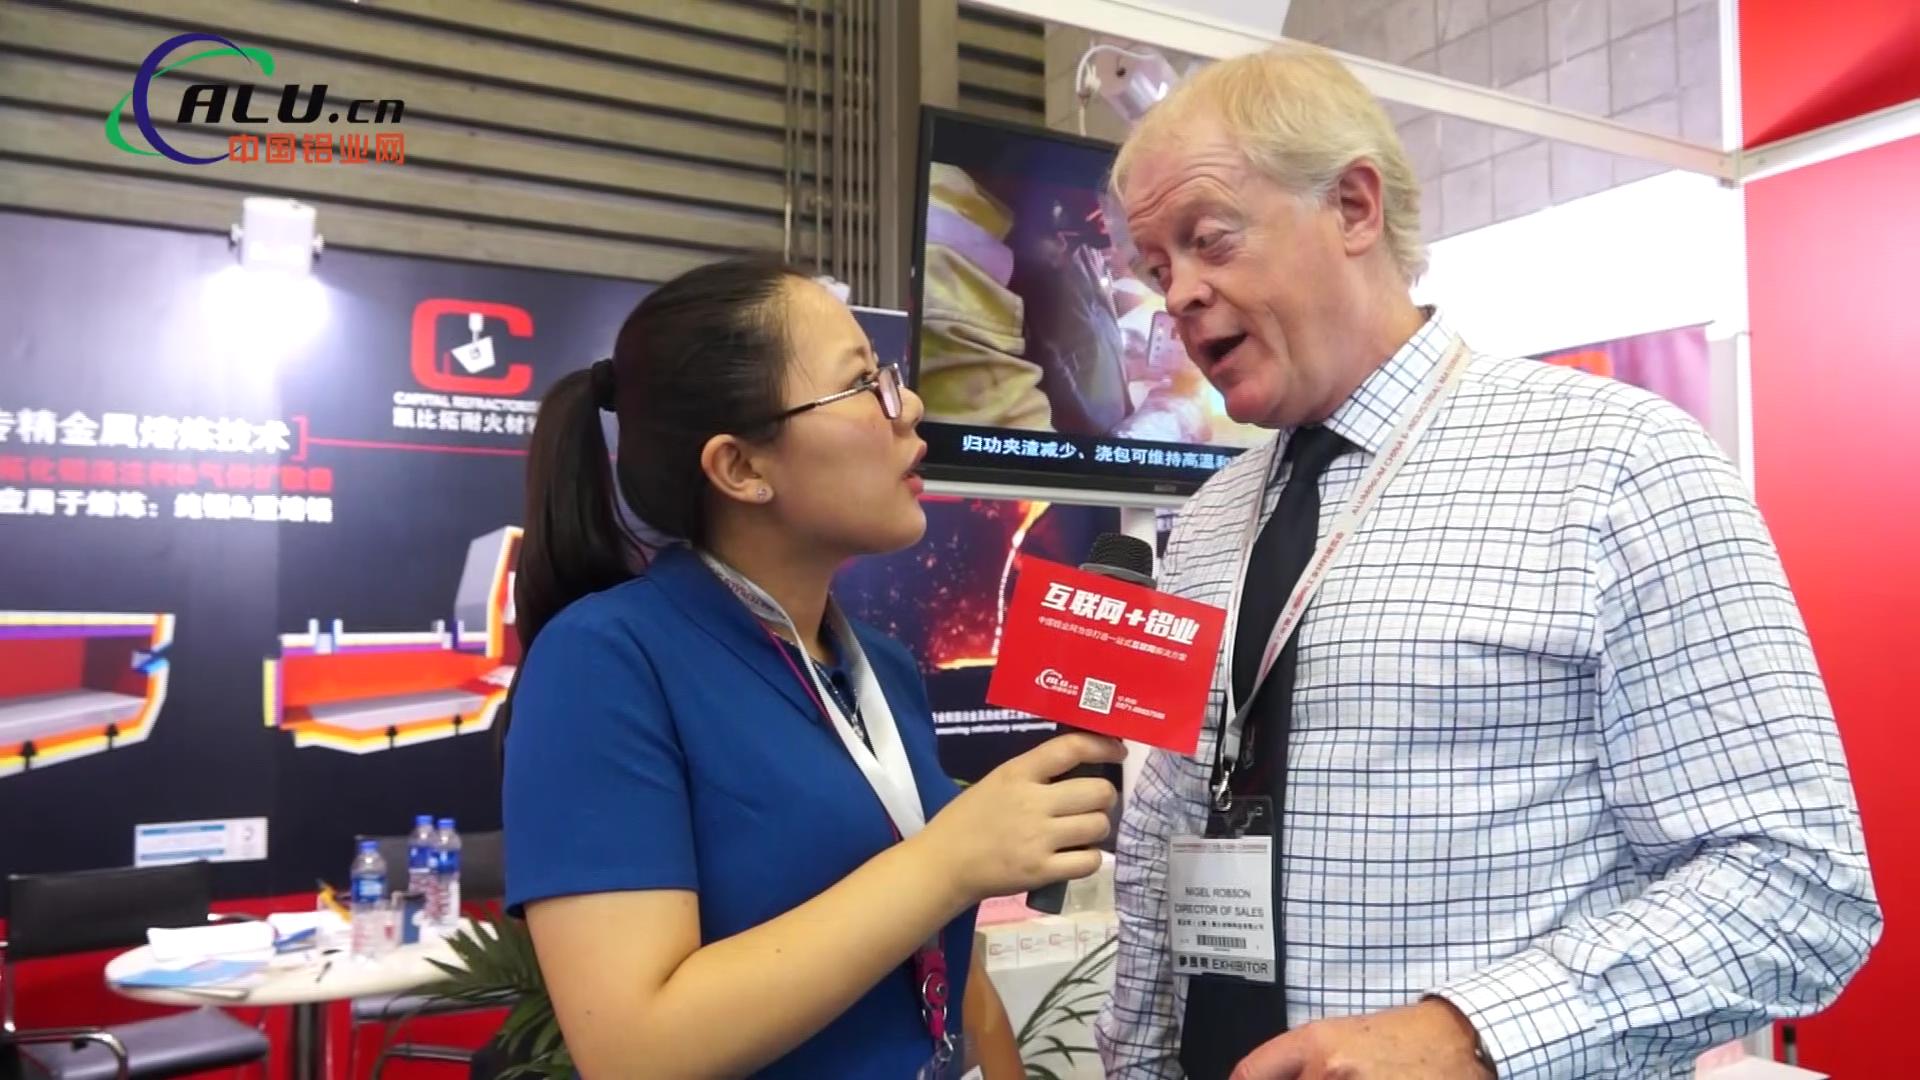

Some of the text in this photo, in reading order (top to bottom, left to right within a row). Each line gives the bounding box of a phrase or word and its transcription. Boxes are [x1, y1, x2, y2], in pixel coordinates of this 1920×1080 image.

[1041, 581, 1200, 646] 互联网+铝业
[1185, 886, 1210, 898] NIGEL
[1174, 903, 1264, 918] DIRECTOR OF SALES
[1212, 959, 1268, 974] EXHIBITOR
